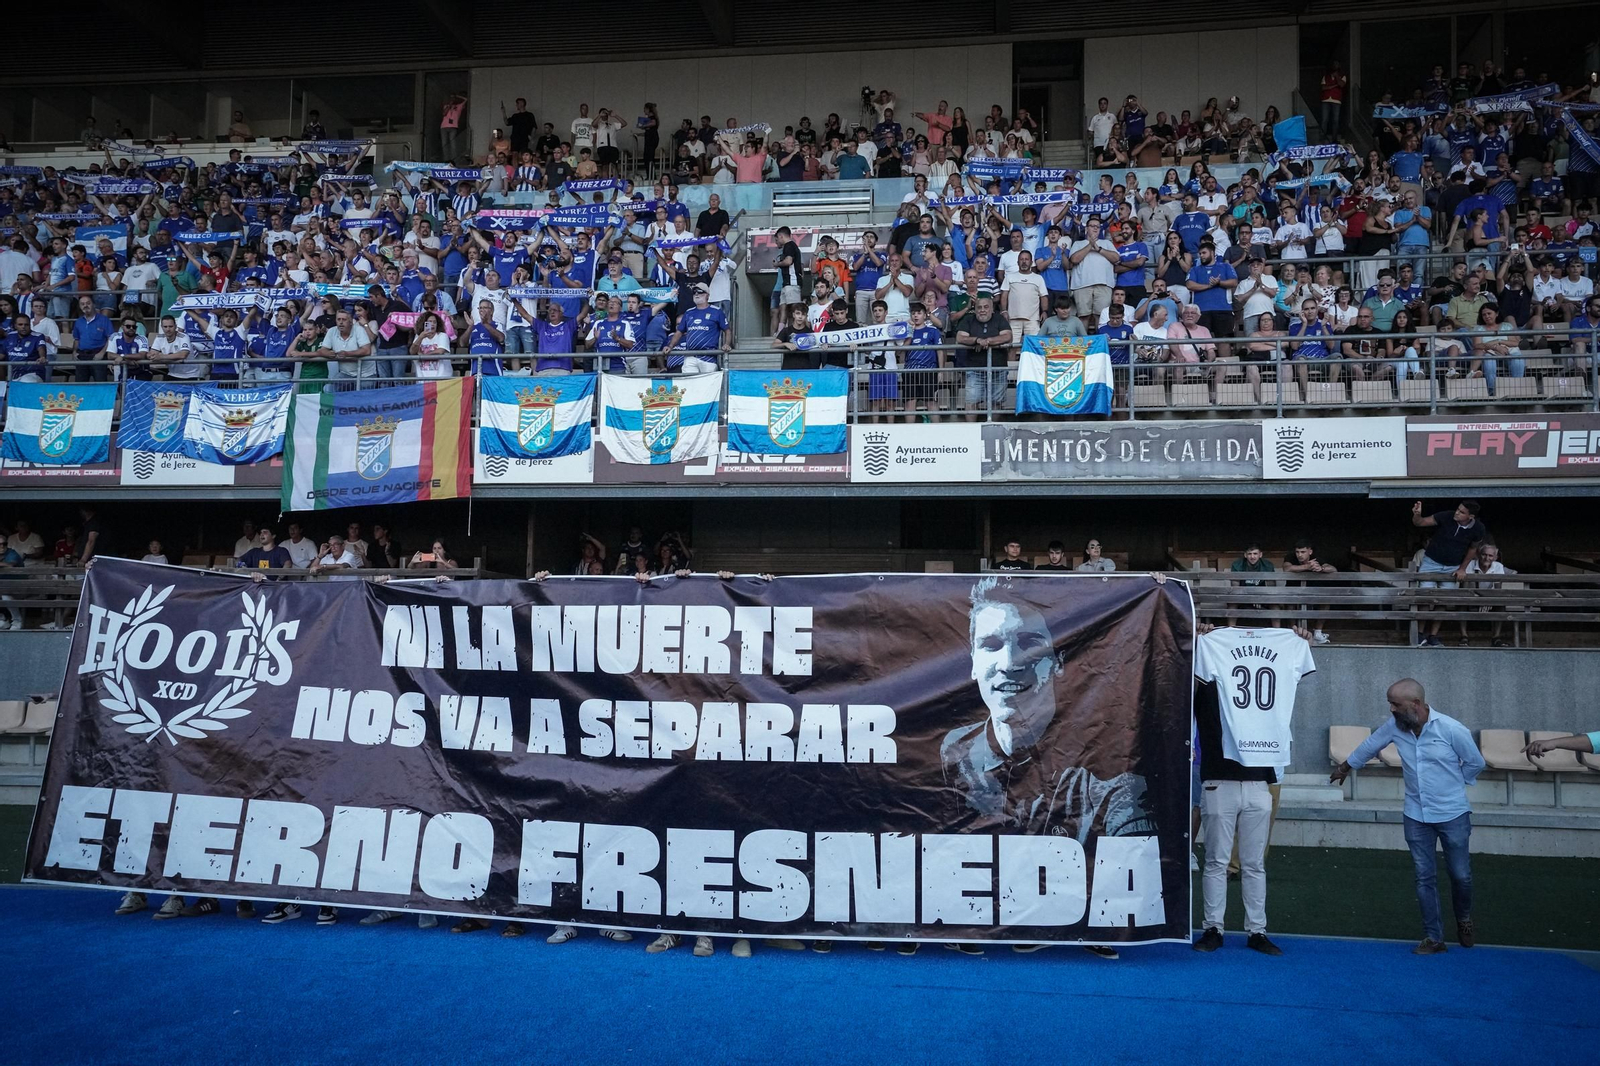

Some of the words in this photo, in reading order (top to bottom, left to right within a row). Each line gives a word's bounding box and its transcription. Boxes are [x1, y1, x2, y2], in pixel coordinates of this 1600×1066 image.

[1488, 102, 1522, 110] XEREZ
[195, 295, 247, 306] XEREZ
[1050, 362, 1082, 395] XEREZ
[223, 392, 260, 403] XEREZ
[319, 407, 335, 418] MI
[339, 404, 380, 416] GRAN
[773, 401, 803, 436] XEREZ
[42, 415, 72, 446] XEREZ
[521, 410, 552, 442] XEREZ
[647, 409, 677, 442] XEREZ
[359, 434, 391, 469] XEREZ
[895, 445, 969, 456] Ayuntamiento
[1120, 438, 1151, 463] DE
[1311, 440, 1392, 451] Ayuntamiento
[1426, 431, 1538, 457] PLAY
[161, 460, 172, 469] de
[173, 461, 197, 470] Jerez
[515, 458, 527, 466] de
[529, 457, 553, 467] Jerez
[895, 456, 908, 464] de
[910, 456, 937, 466] Jerez
[1311, 451, 1325, 460] de
[1327, 451, 1357, 461] Jerez
[7, 469, 43, 477] EXPLORA,
[45, 469, 81, 477] DISFRUTA,
[723, 465, 762, 473] EXPLORA,
[765, 465, 806, 473] DISFRUTA,
[306, 486, 349, 500] DESDE
[351, 484, 380, 495] QUE
[382, 478, 442, 493] NACISTE
[78, 603, 301, 687] HOOLS
[380, 604, 445, 670] NI
[451, 605, 518, 672] LA
[531, 605, 813, 676] MUERTE
[1230, 644, 1279, 663] FRESNEDA
[152, 679, 198, 702] XCD
[1231, 664, 1277, 711] 30
[290, 685, 427, 748] NOS
[439, 694, 514, 752] VA
[526, 697, 567, 755] A
[578, 698, 898, 764] SEPARAR
[43, 784, 495, 902] ETERNO
[516, 818, 1167, 929] FRESNEDA
